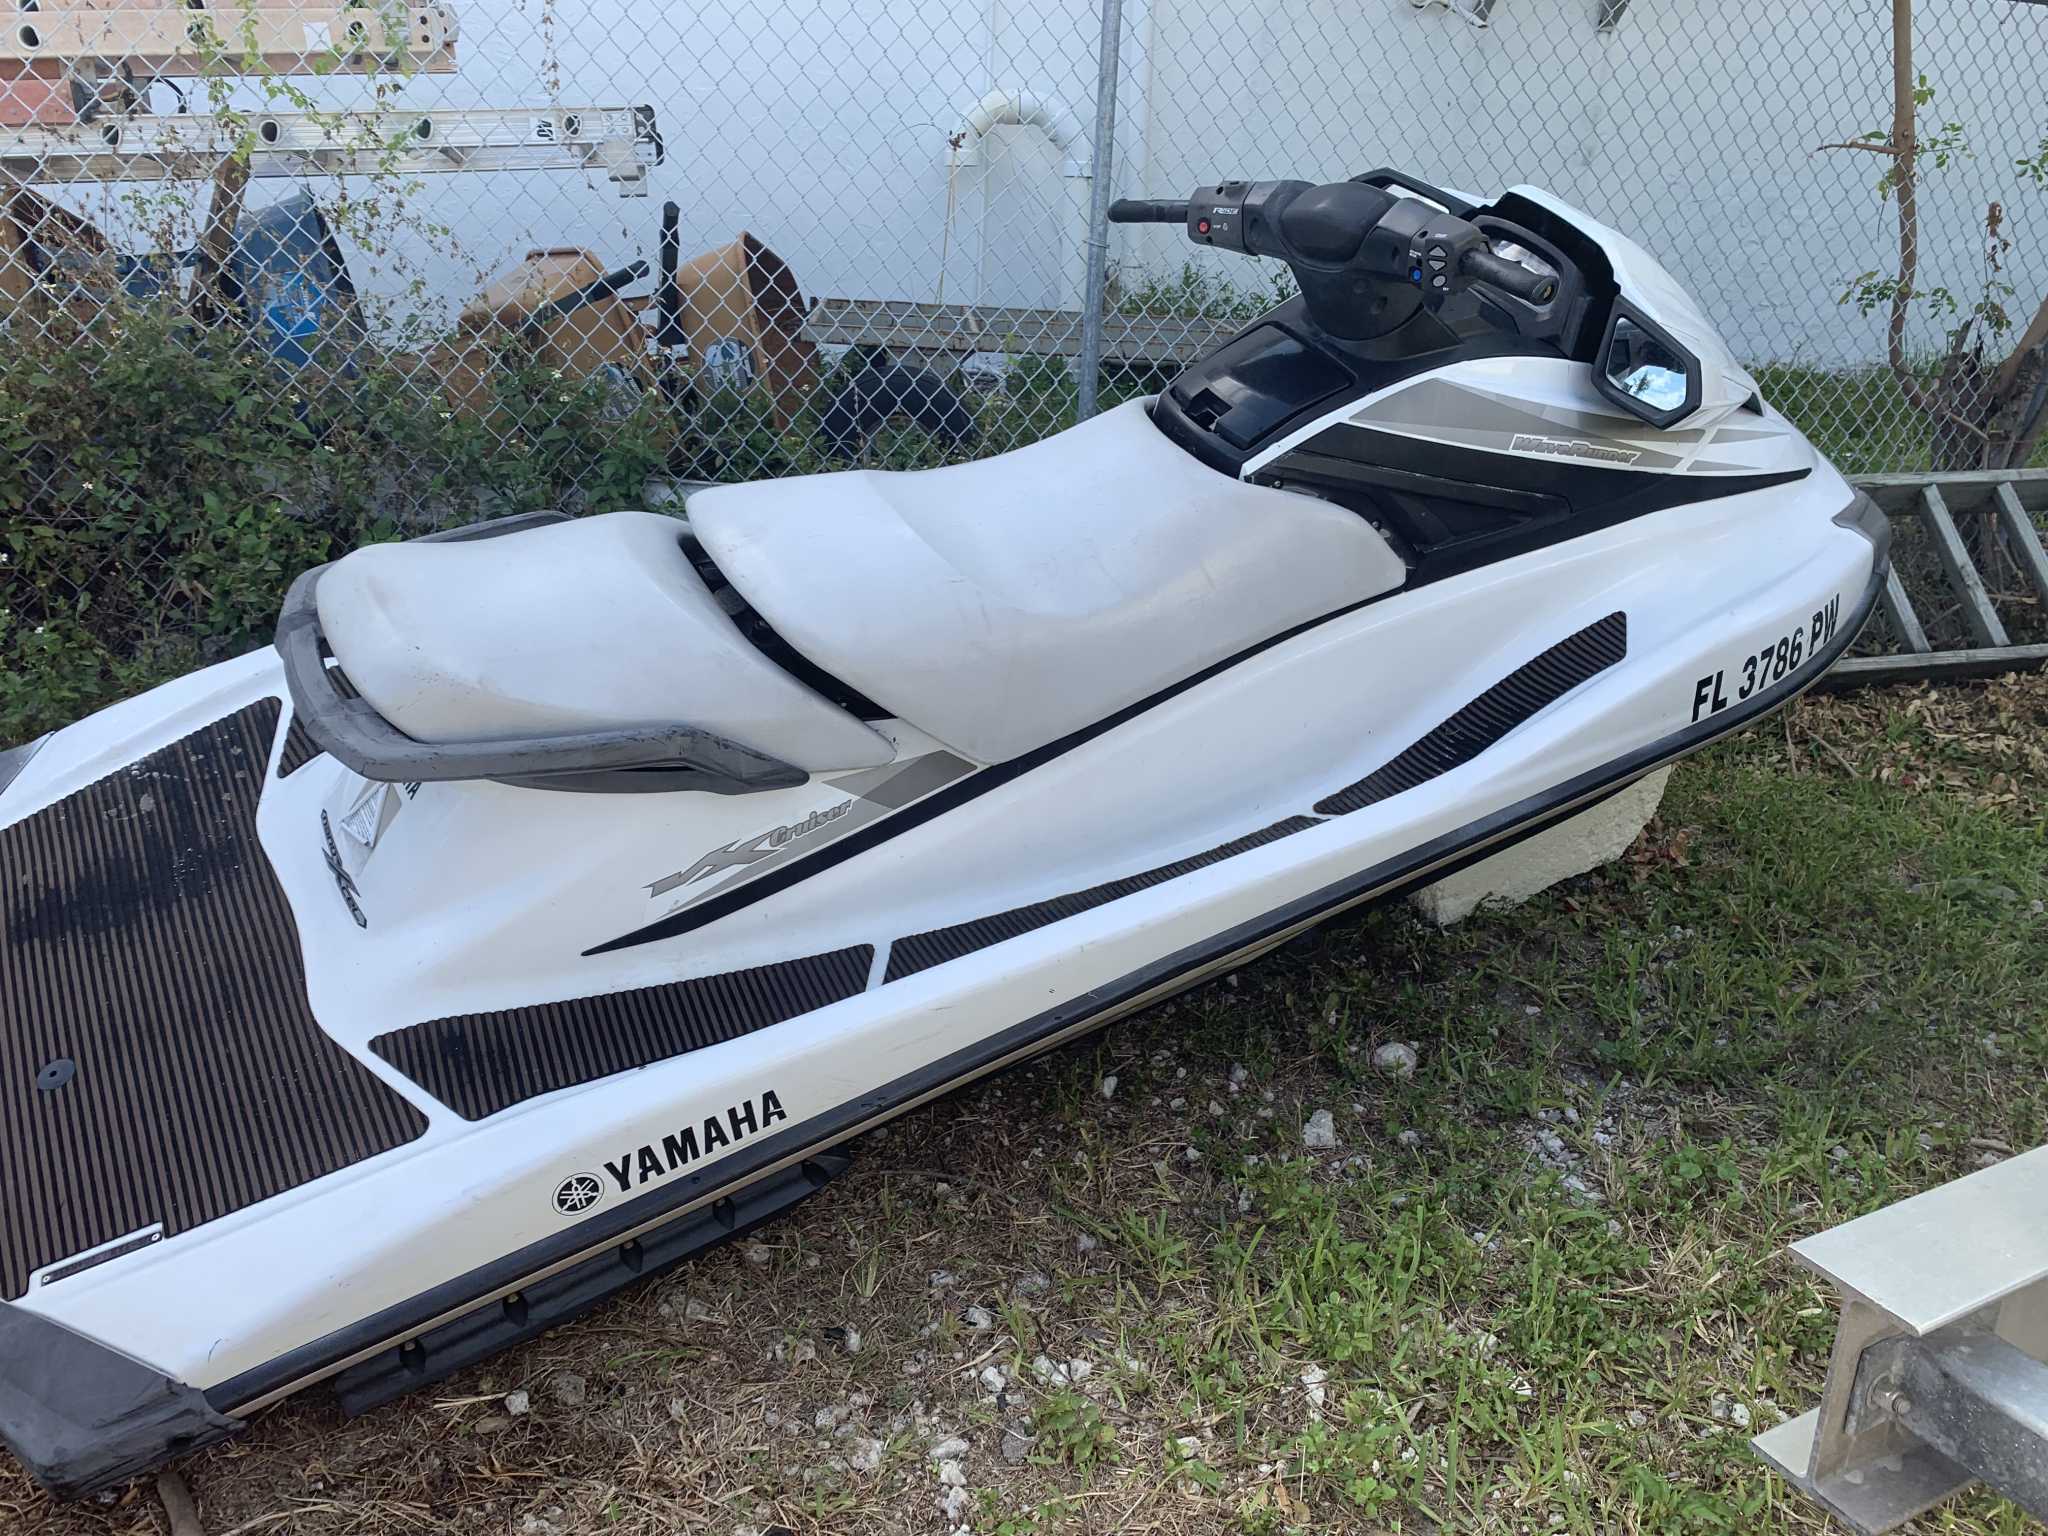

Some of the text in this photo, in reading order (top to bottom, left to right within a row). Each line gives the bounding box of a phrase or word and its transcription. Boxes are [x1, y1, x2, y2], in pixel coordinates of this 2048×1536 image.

[1511, 434, 1641, 464] WaveRunner
[1692, 593, 1840, 723] FL 3786 PW
[768, 799, 852, 847] Cruiser
[603, 1090, 787, 1193] YAMAHA
